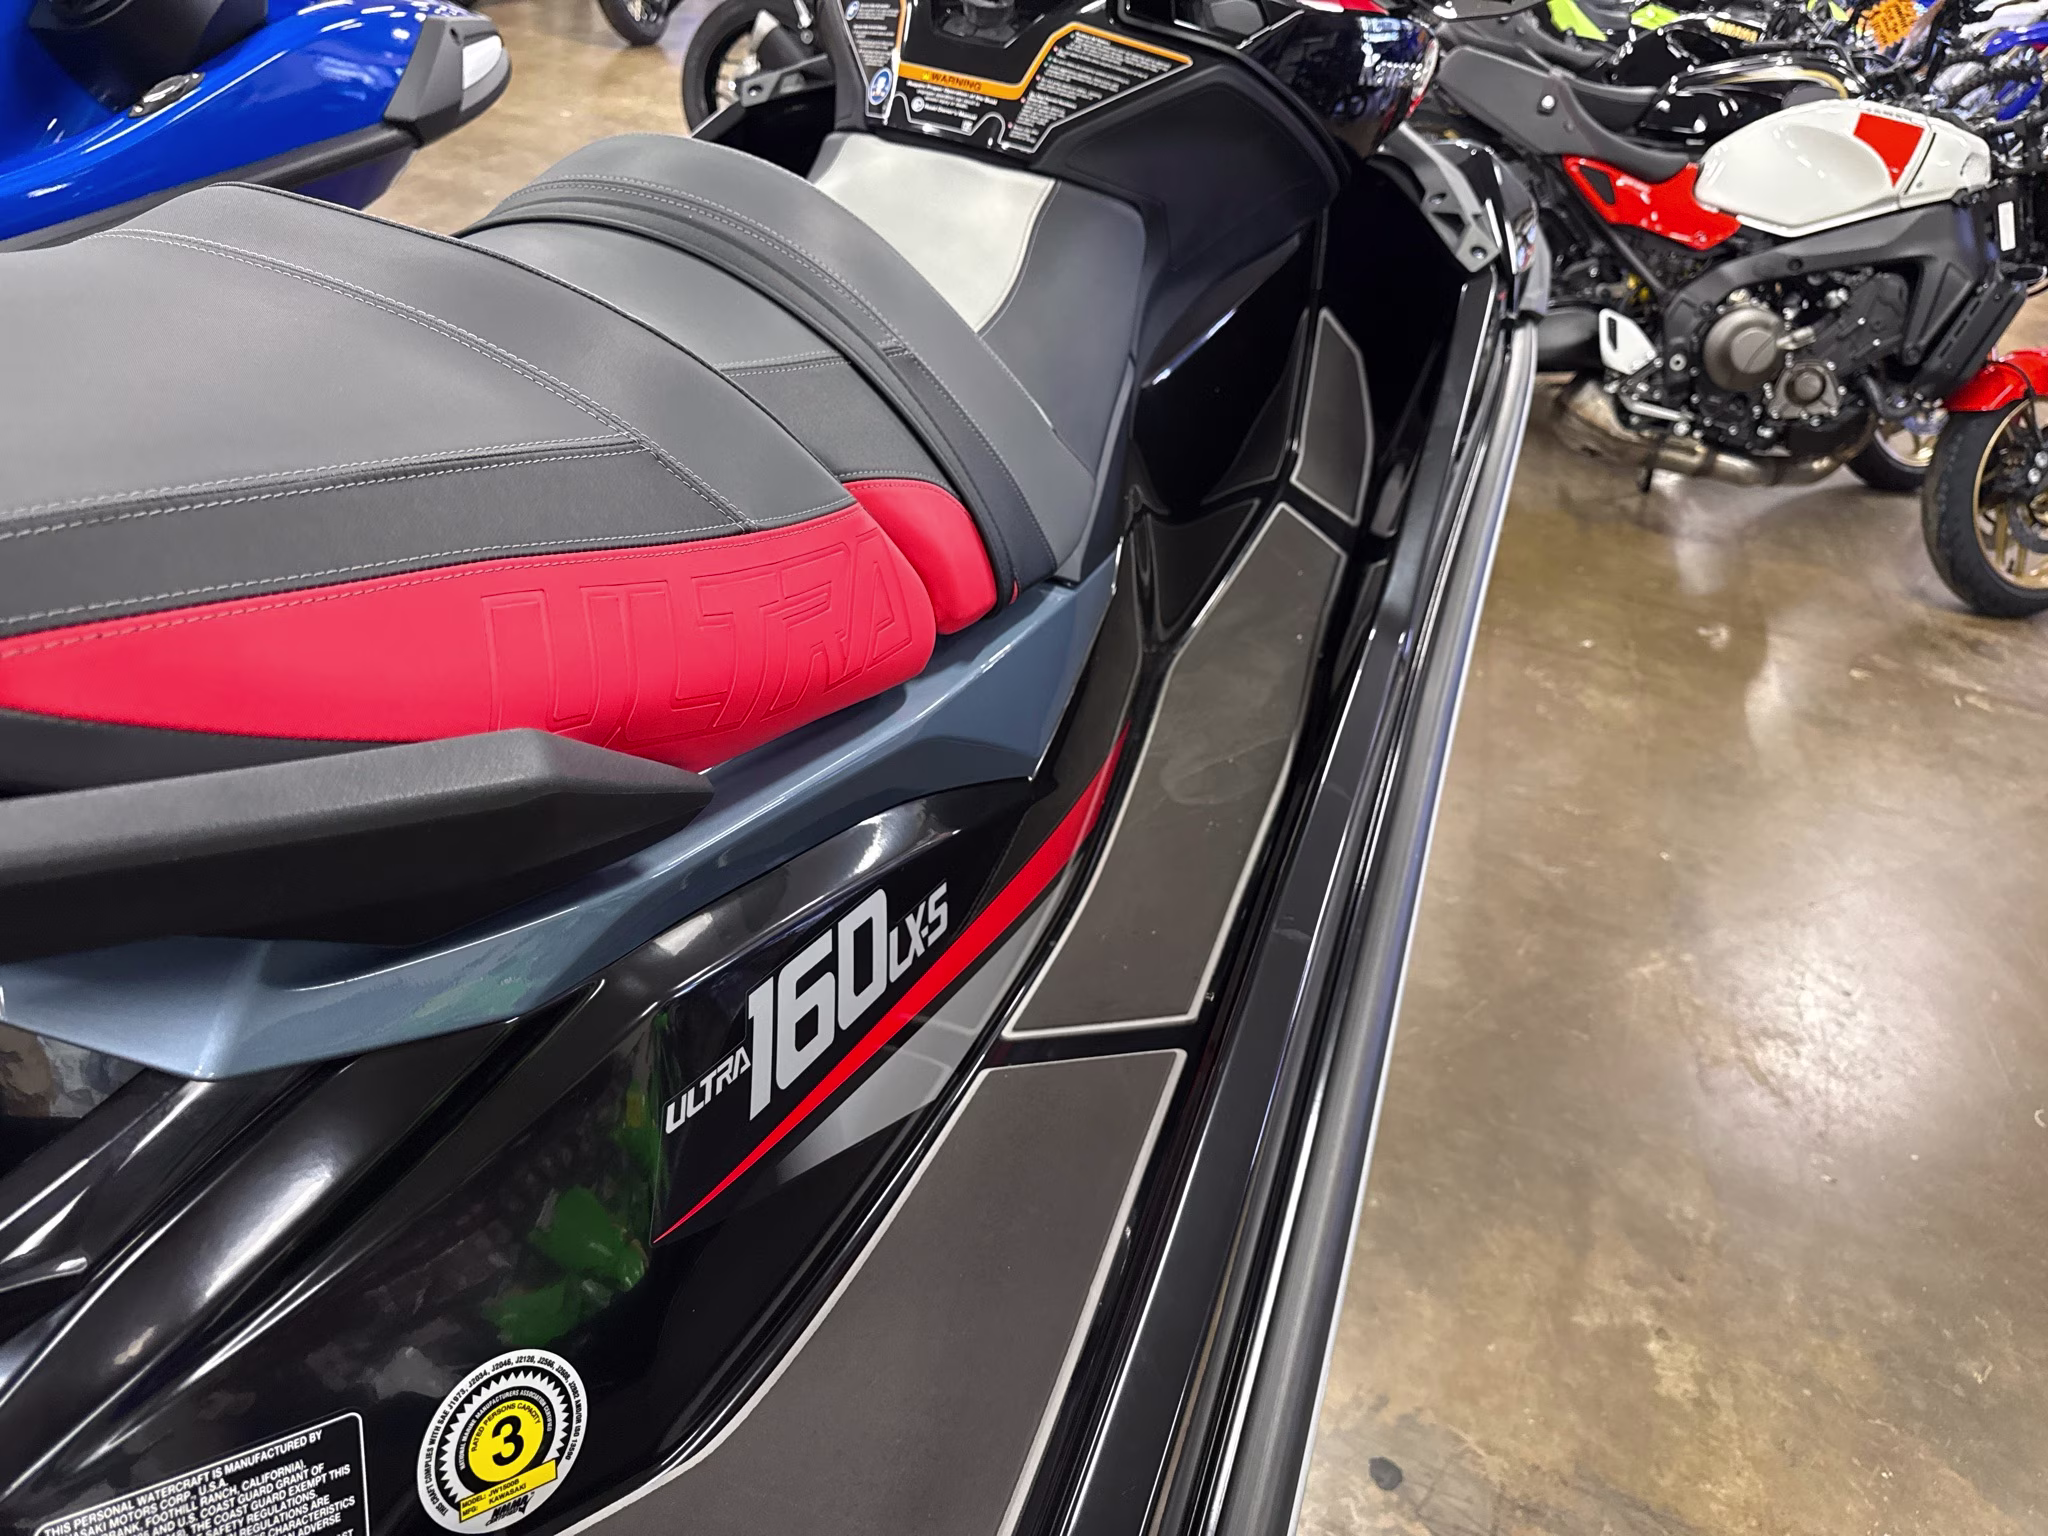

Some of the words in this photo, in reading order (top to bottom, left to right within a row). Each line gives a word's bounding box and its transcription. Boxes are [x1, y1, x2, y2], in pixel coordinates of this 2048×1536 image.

[931, 72, 982, 91] WARNING
[665, 1046, 751, 1134] ULTRA
[748, 888, 888, 1122] 160
[468, 1369, 490, 1388] J2034,
[438, 1410, 450, 1425] SAE
[448, 1387, 469, 1411] J1973,
[475, 1389, 519, 1419] MANUFACTURERS
[429, 1426, 441, 1445] WITH
[471, 1426, 485, 1453] RATED
[483, 1403, 516, 1426] PERSONS
[517, 1402, 541, 1424] CAPACITY
[492, 1415, 525, 1466] 3
[44, 1522, 72, 1536] THIS
[73, 1500, 135, 1530] PERSONAL
[136, 1471, 210, 1507] WATERCRAFT
[212, 1467, 223, 1479] IS
[224, 1436, 307, 1475] MANUFACTURED
[309, 1429, 322, 1443] BY
[424, 1447, 434, 1484] COMPLIES
[109, 1502, 158, 1529] MOTORS
[198, 1478, 229, 1496] U.S.A.
[145, 1500, 198, 1528] FOOTHILL
[200, 1483, 240, 1507] RANCH,
[152, 1520, 175, 1536] AND
[177, 1512, 198, 1528] U.S.
[200, 1499, 235, 1519] COAST
[237, 1483, 274, 1505] GUARD
[275, 1469, 309, 1490] GRANT
[310, 1463, 325, 1476] OF
[190, 1518, 212, 1534] THE
[213, 1503, 248, 1526] COAST
[250, 1490, 286, 1511] GUARD
[288, 1474, 327, 1496] EXEMPT
[328, 1464, 352, 1480] THIS
[205, 1516, 244, 1536] SAFETY
[246, 1489, 318, 1525] REGULATIONS.
[426, 1482, 440, 1505] CRAFT
[435, 1502, 449, 1517] THIS
[488, 1482, 527, 1504] KAWASAKI
[240, 1503, 309, 1536] REGULATIONS
[310, 1494, 330, 1511] ARE
[267, 1495, 356, 1536] CHARACTERISTICS
[297, 1512, 342, 1536] ADVERSE
